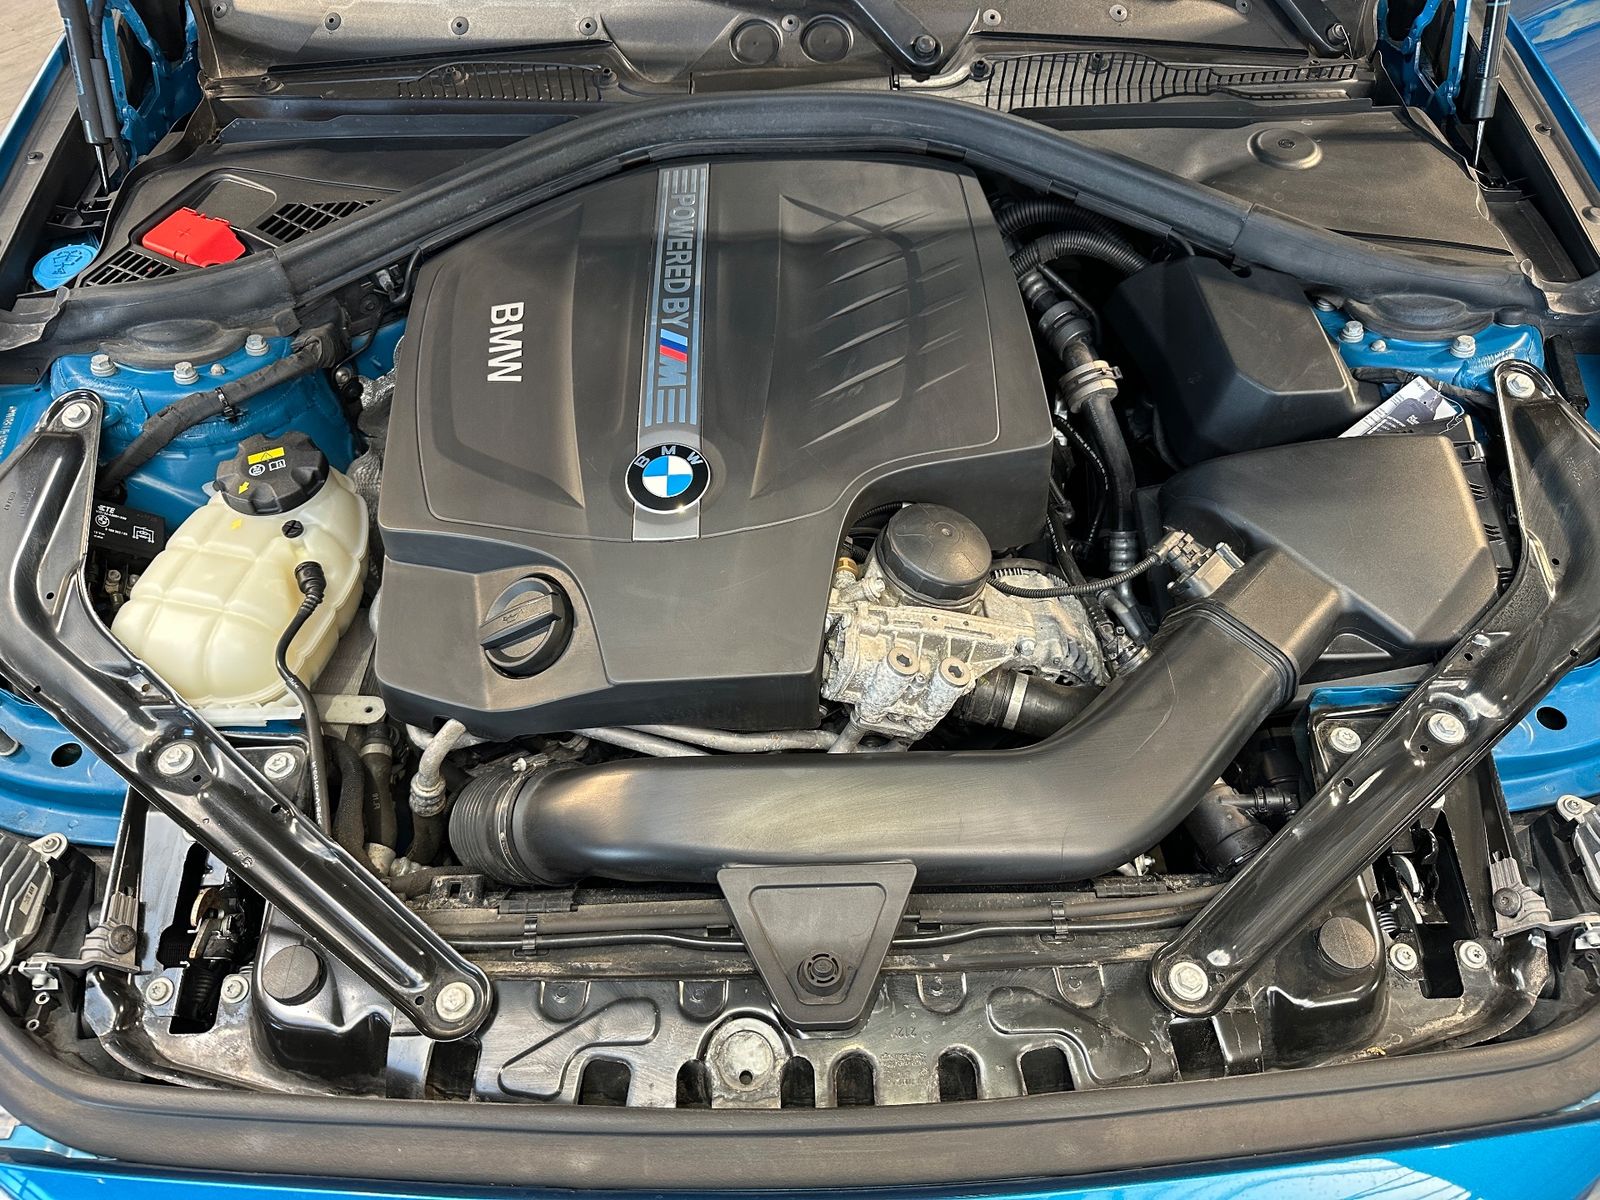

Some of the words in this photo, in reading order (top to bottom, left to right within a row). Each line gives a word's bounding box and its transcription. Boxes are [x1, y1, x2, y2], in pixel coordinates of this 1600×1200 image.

[664, 193, 696, 294] POWERED
[661, 297, 690, 329] BY
[487, 302, 524, 382] BMW
[634, 445, 703, 469] BMW
